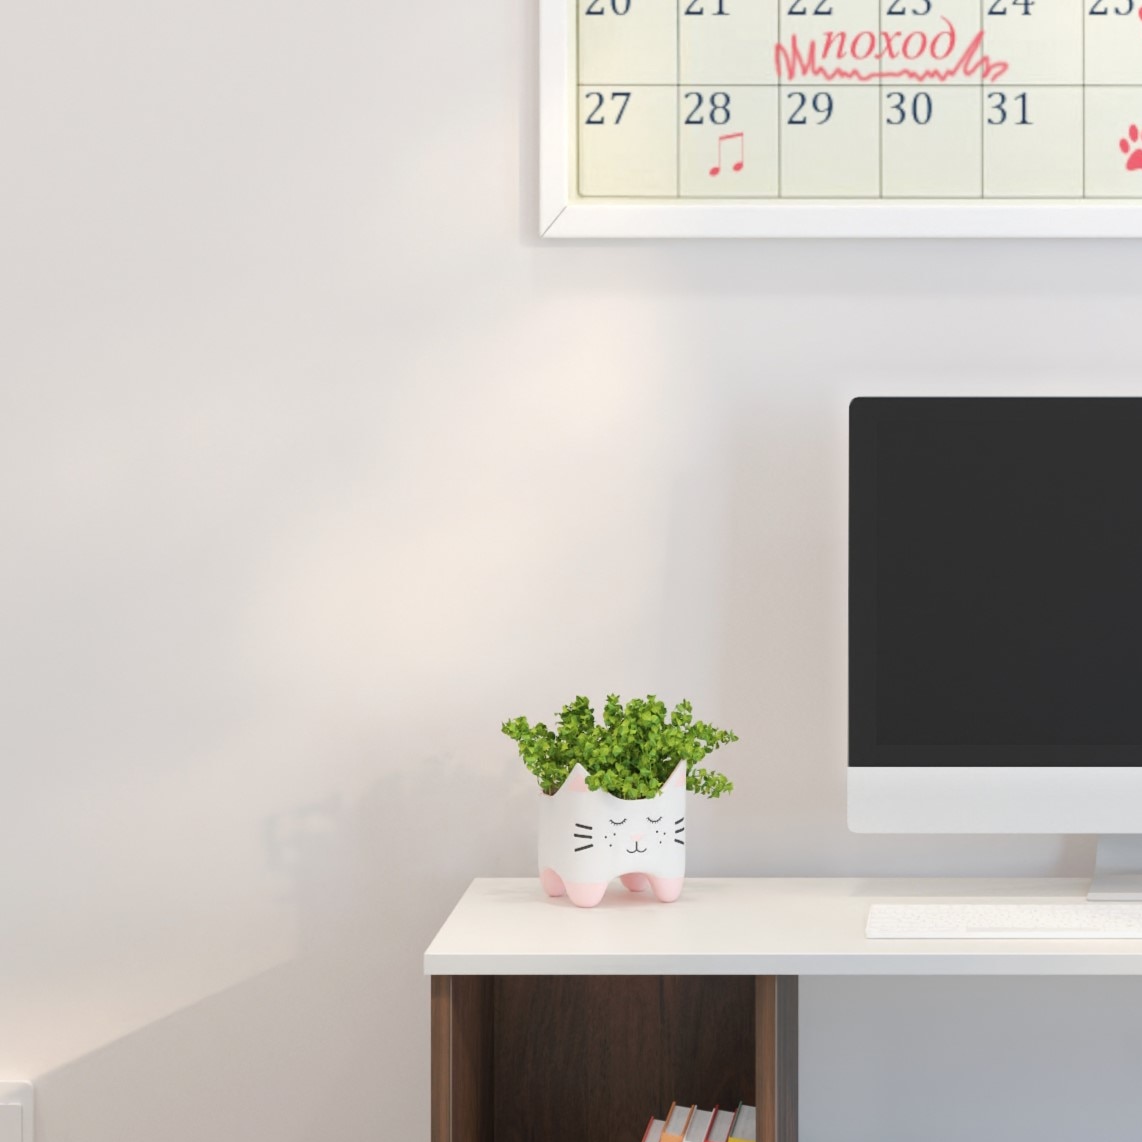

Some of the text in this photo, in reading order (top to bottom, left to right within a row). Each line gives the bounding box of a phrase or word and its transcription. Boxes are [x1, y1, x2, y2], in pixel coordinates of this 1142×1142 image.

[585, 92, 632, 125] 27
[684, 92, 731, 125] 28
[787, 92, 834, 125] 29
[886, 92, 933, 125] 30
[987, 92, 1034, 125] 31
